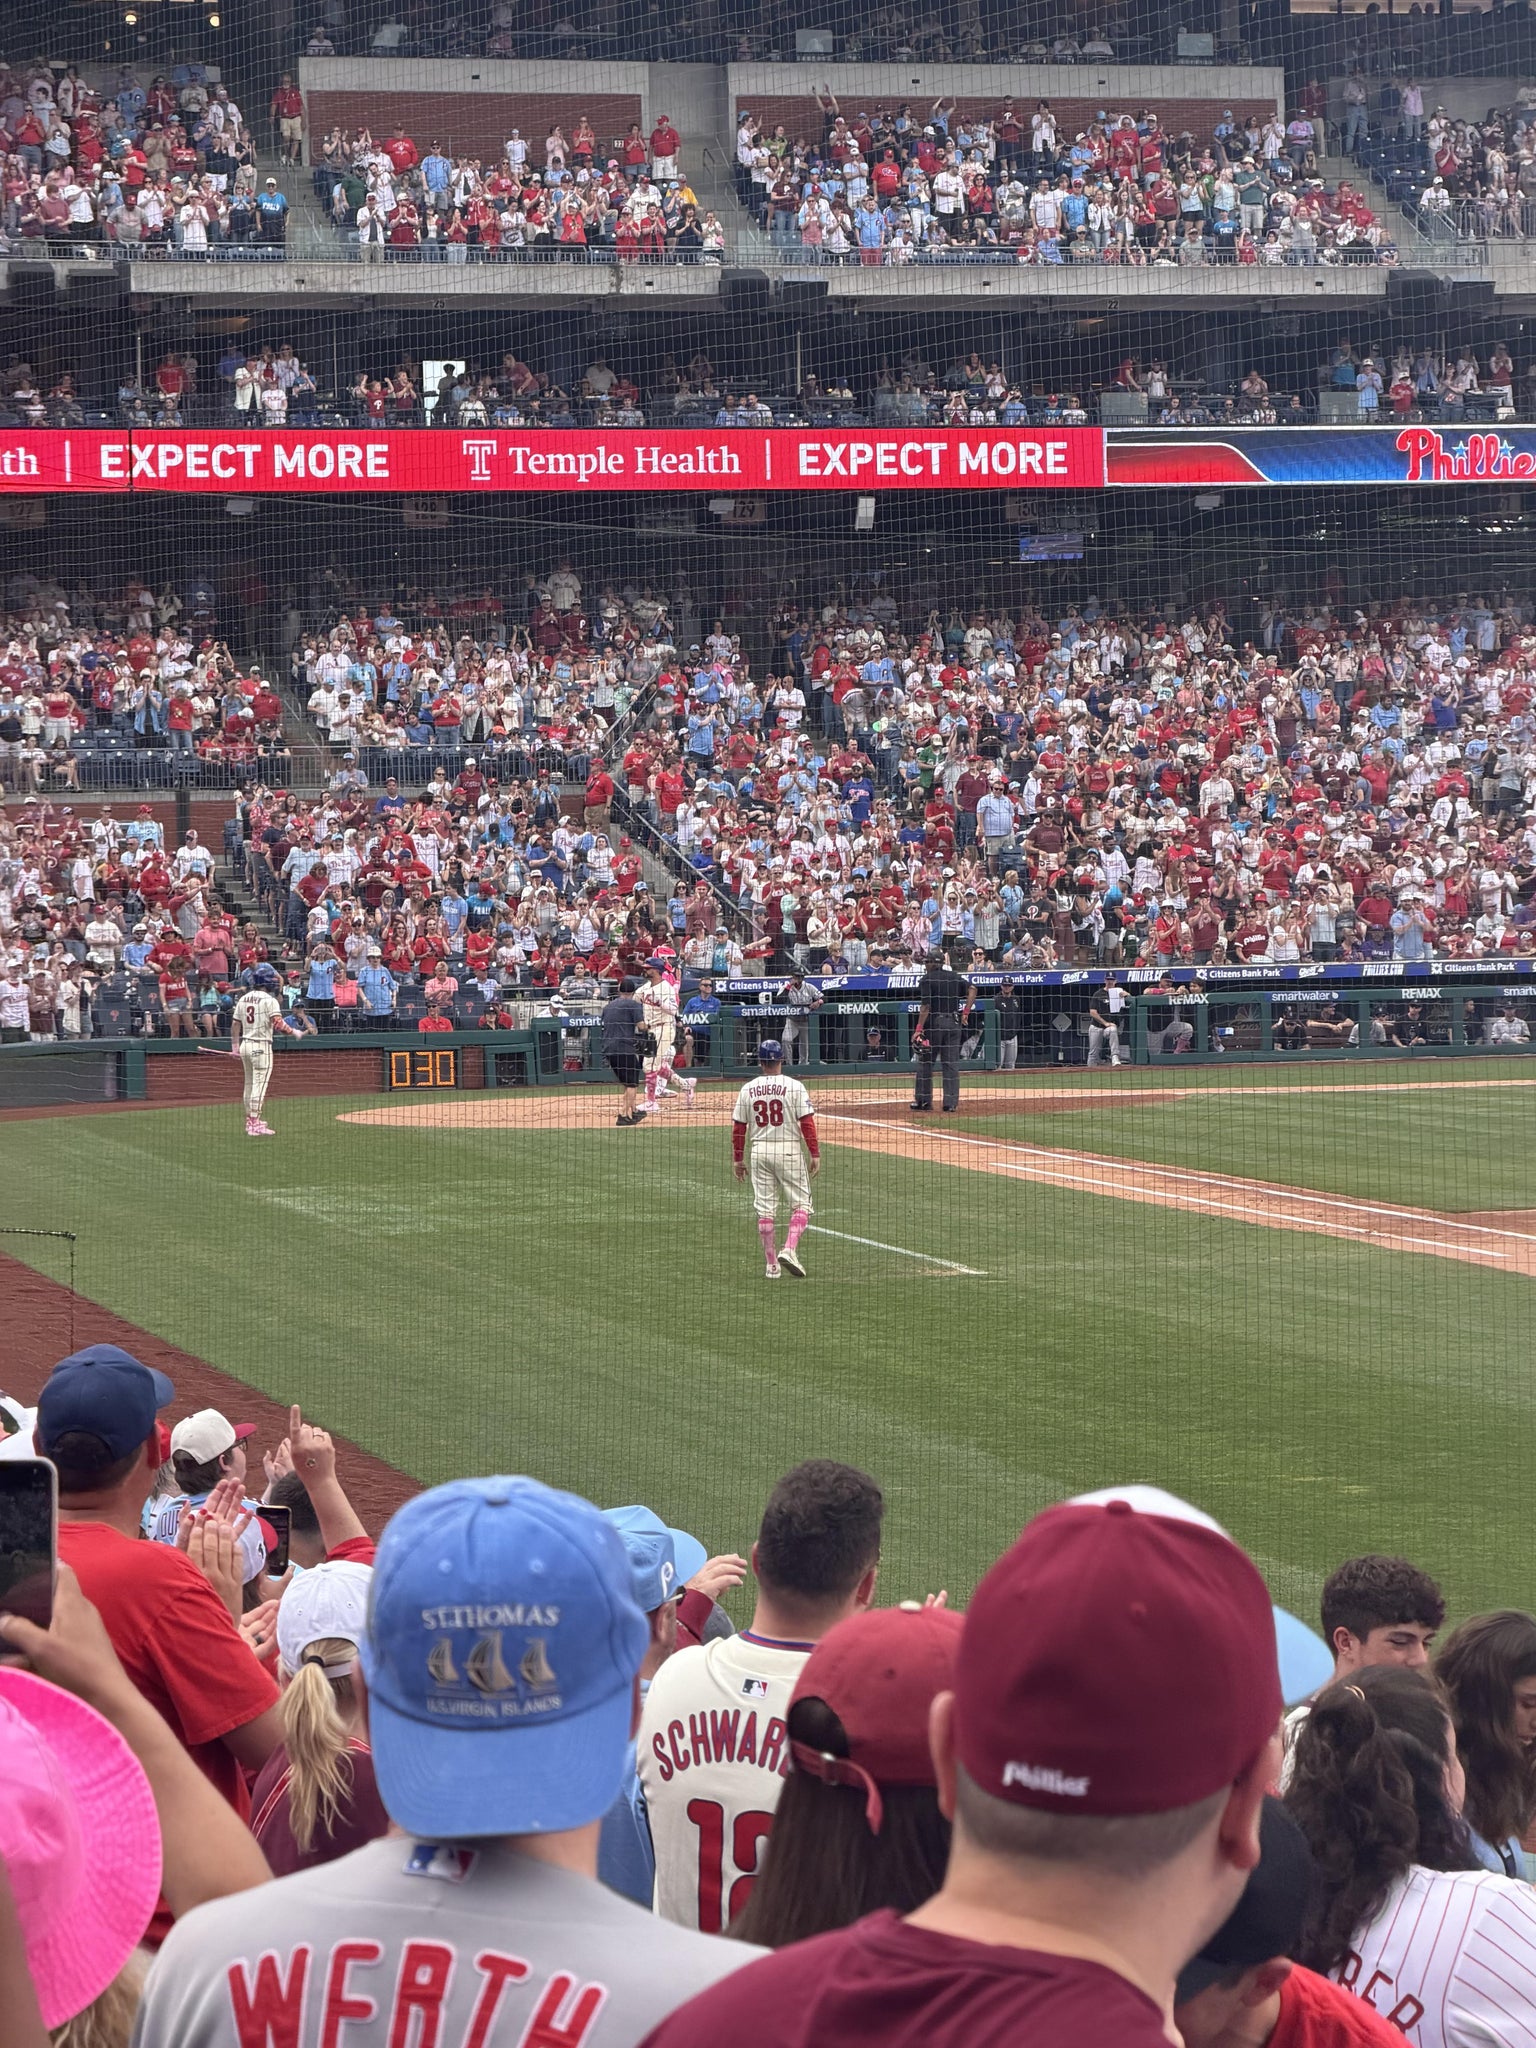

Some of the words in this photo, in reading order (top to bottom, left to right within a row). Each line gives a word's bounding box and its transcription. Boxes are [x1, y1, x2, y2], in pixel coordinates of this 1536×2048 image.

[0, 446, 40, 476] th
[100, 444, 262, 479] EXPECT
[274, 444, 389, 478] MORE
[508, 446, 625, 483] Temple
[634, 446, 742, 475] Health
[798, 441, 948, 476] EXPECT
[958, 441, 1068, 475] MORE
[1209, 969, 1241, 979] Citizens
[1241, 968, 1262, 978] Bank
[1263, 967, 1281, 977] Park
[1444, 963, 1476, 973] Citizens
[1476, 962, 1497, 972] Bank
[1497, 962, 1516, 971] Park
[887, 975, 923, 988] PHILLIES.C
[1026, 973, 1044, 984] Park
[1127, 970, 1168, 983] PHILLIES.CO
[729, 980, 762, 991] Citizens
[763, 979, 783, 990] Bank
[1271, 990, 1330, 1002] smartwater
[246, 1005, 255, 1025] 3
[741, 1005, 801, 1017] smartwater
[569, 1016, 604, 1027] smart
[748, 1083, 788, 1099] FIGUEROA
[753, 1098, 784, 1128] 38
[652, 1709, 789, 1782] SCHWAR
